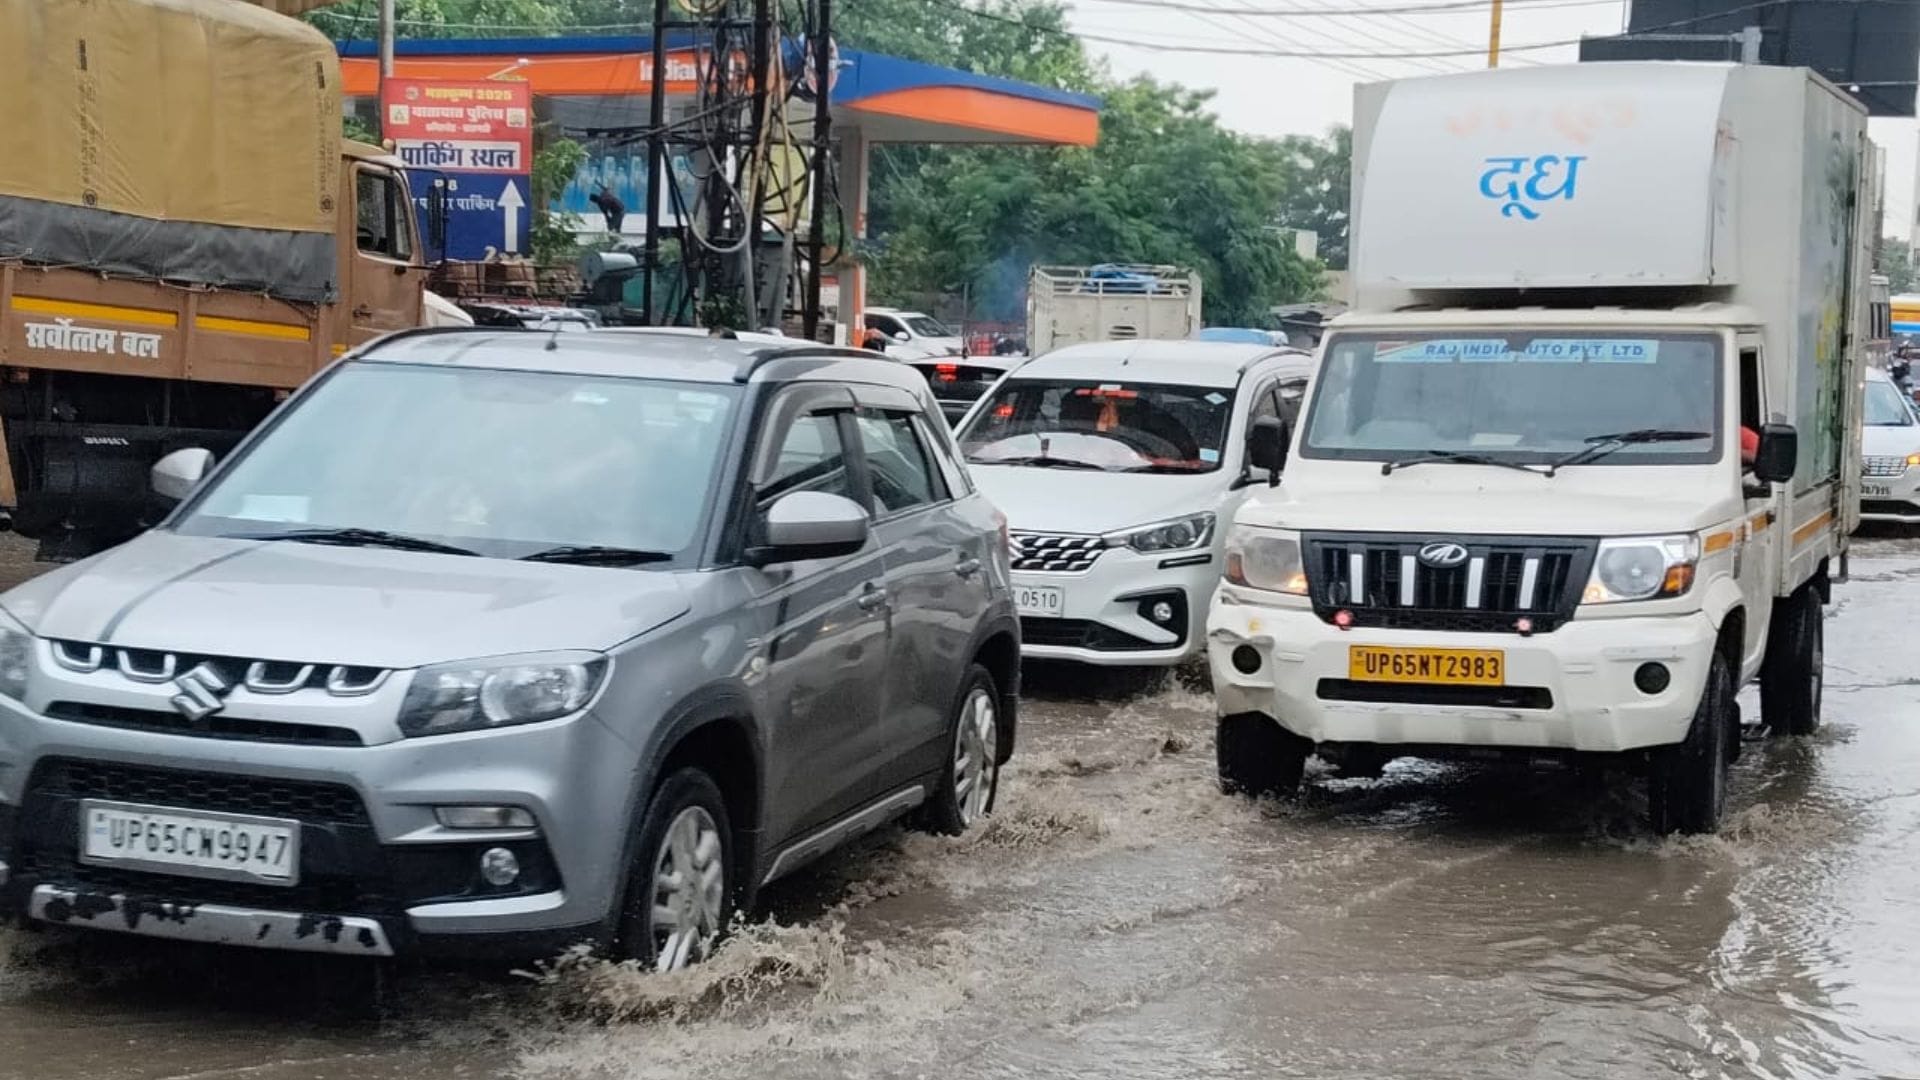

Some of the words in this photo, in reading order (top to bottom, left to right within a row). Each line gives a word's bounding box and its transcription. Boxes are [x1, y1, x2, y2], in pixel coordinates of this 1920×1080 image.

[400, 141, 463, 166] पार्किंग
[470, 148, 516, 168] स्थल
[1479, 154, 1588, 220] दूध
[24, 317, 118, 354] सर्वोत्तम
[120, 331, 162, 359] बल
[1425, 344, 1457, 356] RAJ
[1524, 344, 1563, 356] UTO
[1366, 652, 1500, 679] UP65NT2983
